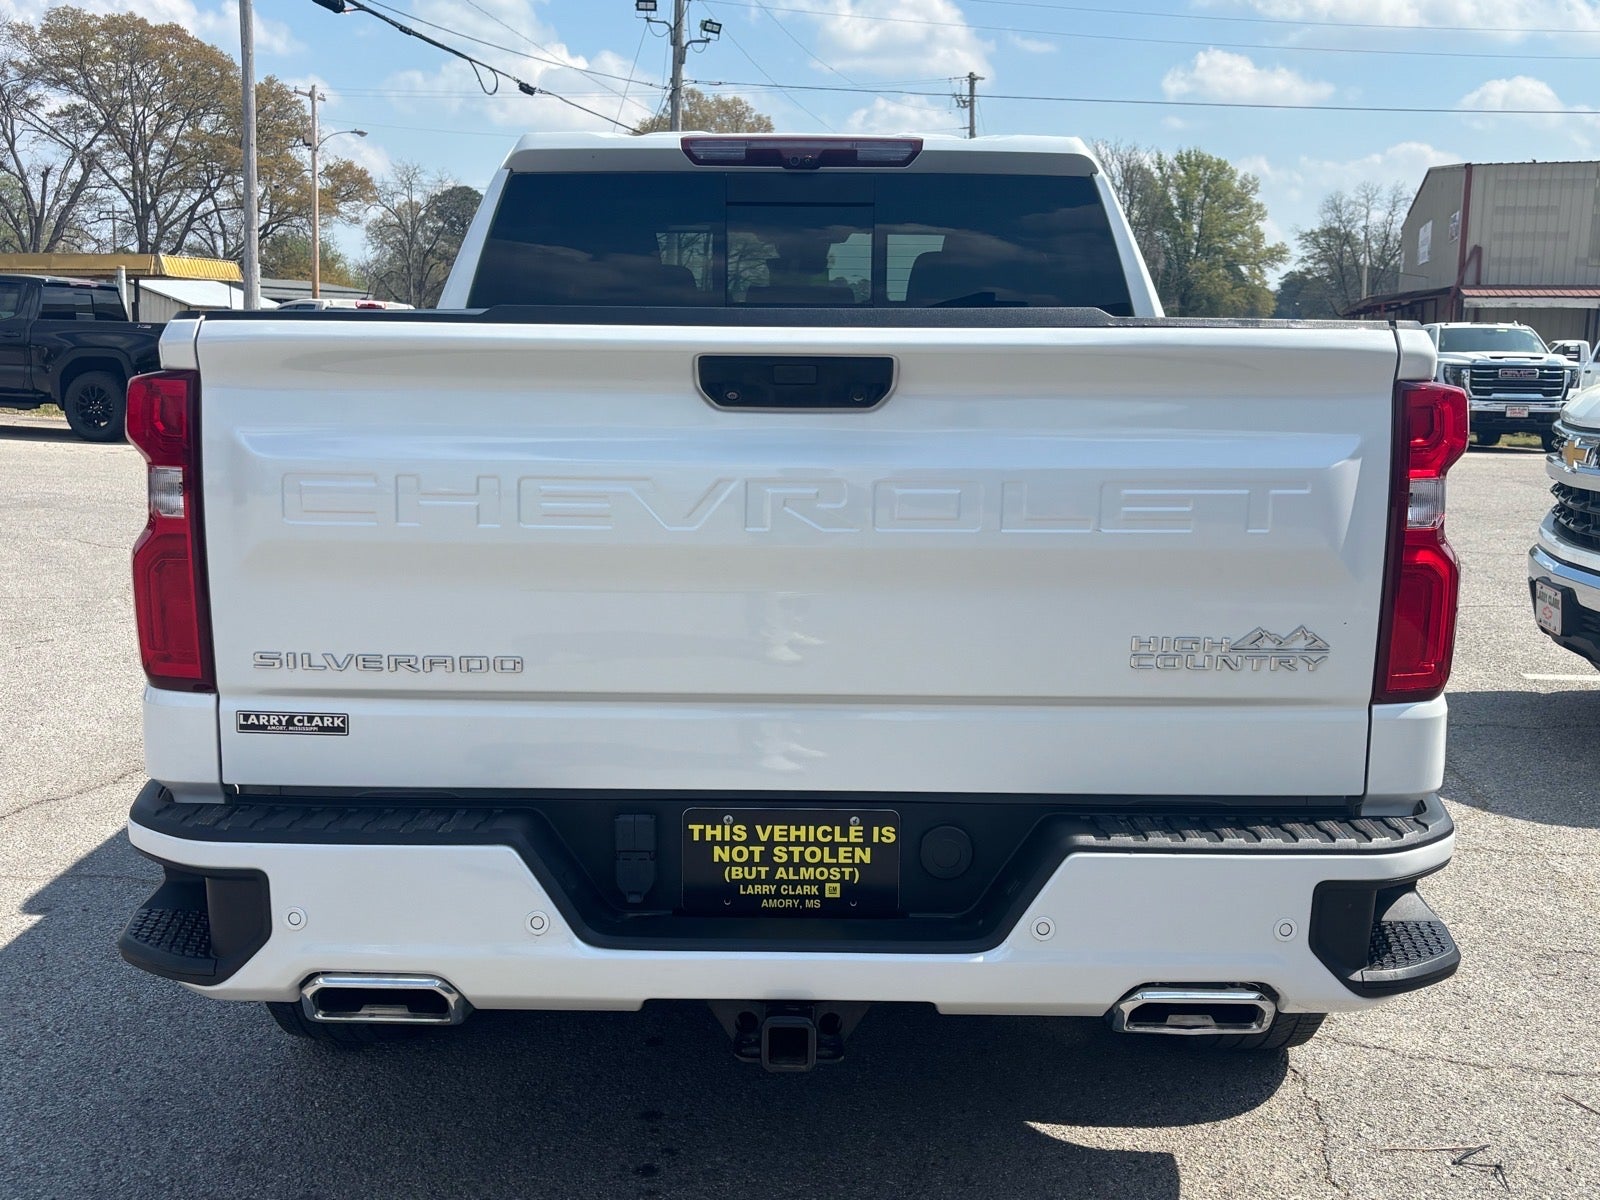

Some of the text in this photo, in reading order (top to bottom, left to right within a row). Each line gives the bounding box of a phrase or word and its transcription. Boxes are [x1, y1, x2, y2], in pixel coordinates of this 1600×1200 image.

[282, 472, 1312, 535] CHEVROLET
[1131, 636, 1231, 653] HIGH
[253, 651, 524, 674] SILVERADO
[1129, 653, 1328, 671] COUNTRY
[239, 714, 345, 728] LARRY CLARK
[688, 823, 897, 844] THIS VEHICLE IS
[713, 845, 872, 864] NOT STOLEN
[724, 867, 860, 884] (BUT ALMOST)
[739, 884, 777, 895] LARRY
[780, 884, 819, 895] CLARK
[761, 899, 821, 909] AMORY, MS
